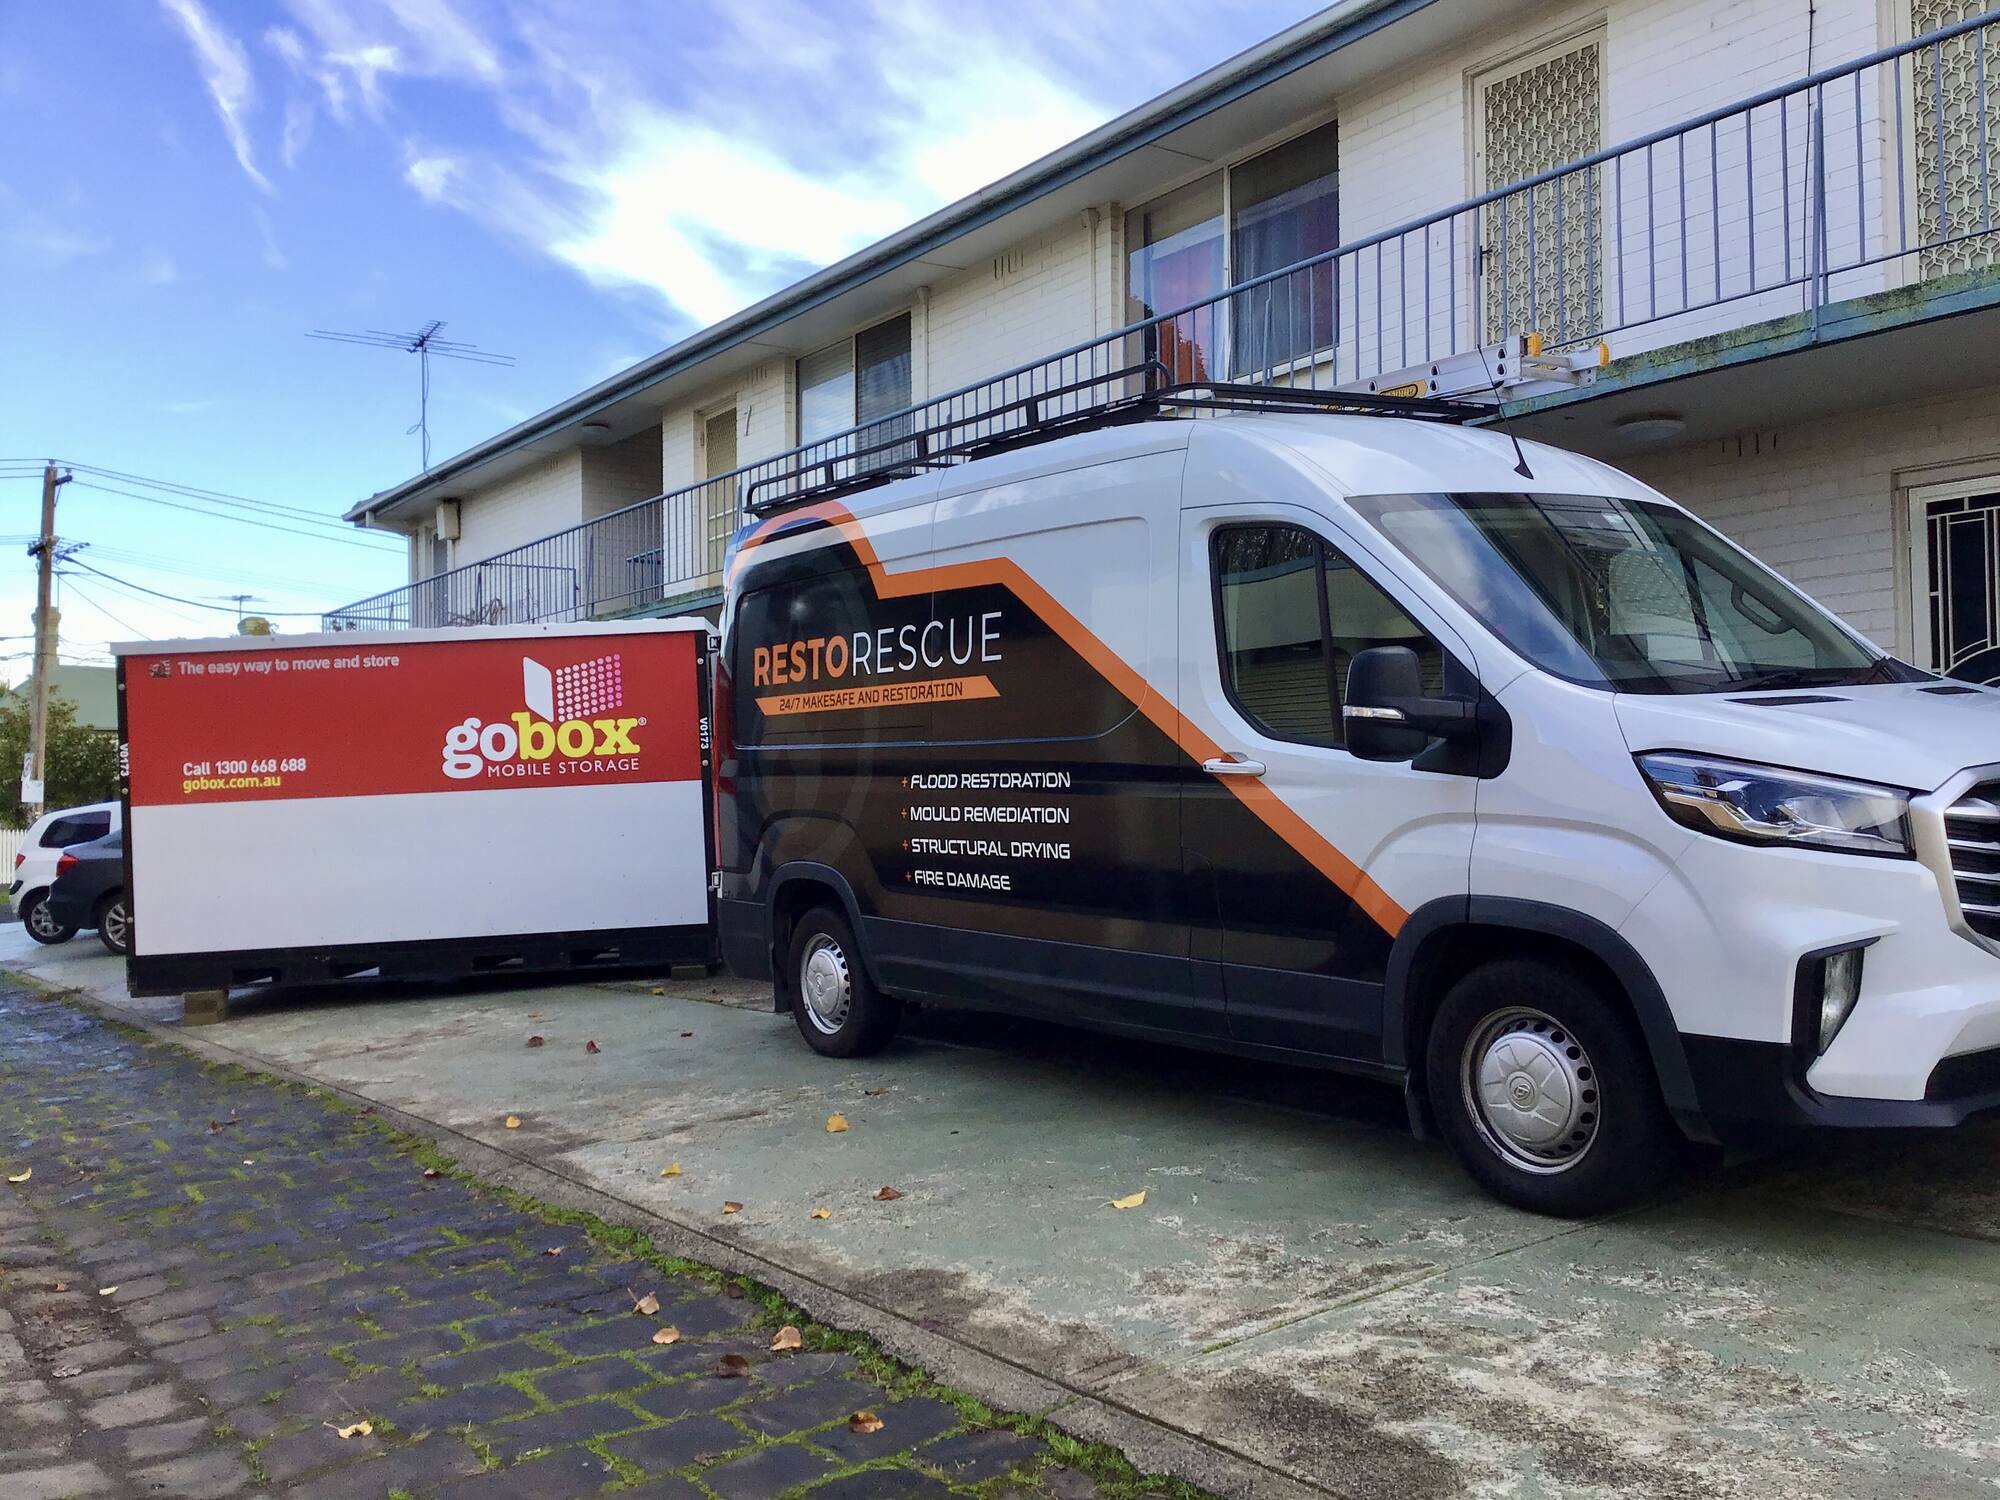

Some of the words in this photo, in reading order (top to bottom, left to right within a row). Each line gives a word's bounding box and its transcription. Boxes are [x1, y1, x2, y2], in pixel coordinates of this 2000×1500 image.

[753, 611, 1003, 687] RESTORESCUE
[177, 661, 205, 675] The
[207, 662, 241, 676] easy
[242, 660, 273, 675] way
[274, 658, 290, 671] to
[292, 658, 331, 670] move
[333, 654, 360, 669] and
[363, 654, 400, 668] store
[778, 694, 801, 712] 24/7
[802, 690, 855, 709] MAKESAFE
[857, 688, 880, 704] AND
[882, 681, 963, 702] RESTORATION
[699, 716, 711, 750] V0173
[119, 743, 130, 777] V0173
[183, 761, 211, 777] Call
[215, 759, 248, 775] 1300
[250, 758, 277, 774] 668
[280, 757, 307, 772] 688
[487, 763, 551, 778] MOBILE
[558, 758, 640, 774] STORAGE
[182, 776, 281, 794] gobox.com.au
[910, 774, 958, 789] FLOOD
[960, 771, 1071, 789] RESTORATION
[910, 806, 961, 822] MOULD
[963, 806, 1070, 824] REMEDIATION
[911, 838, 1008, 857] STRUCTURAL
[1010, 841, 1071, 860] DRYING
[914, 869, 945, 886] FIRE
[946, 871, 1011, 891] DAMAGE
